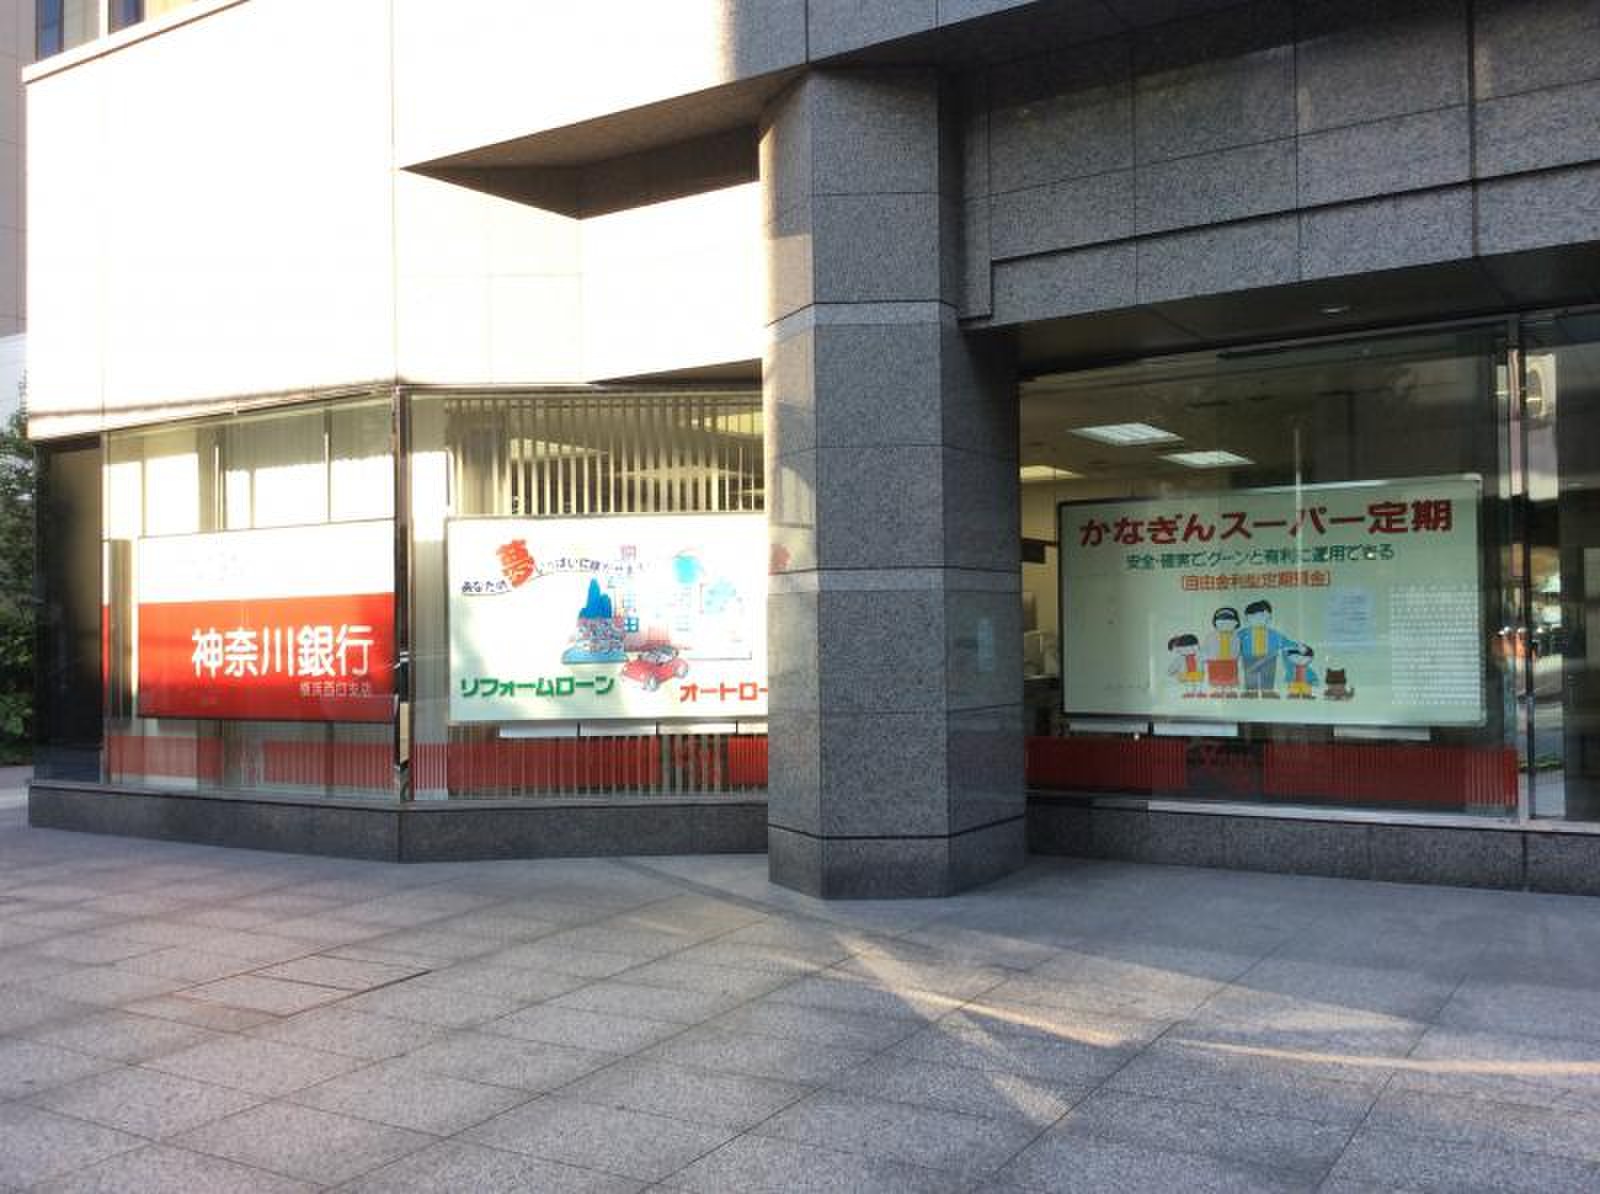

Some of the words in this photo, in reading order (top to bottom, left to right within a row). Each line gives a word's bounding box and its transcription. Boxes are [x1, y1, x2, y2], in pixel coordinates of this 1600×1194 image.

[1079, 499, 1453, 547] かなぎんスーパー定期
[191, 623, 375, 678] 神奈川銀行
[460, 676, 615, 698] リフォームローン
